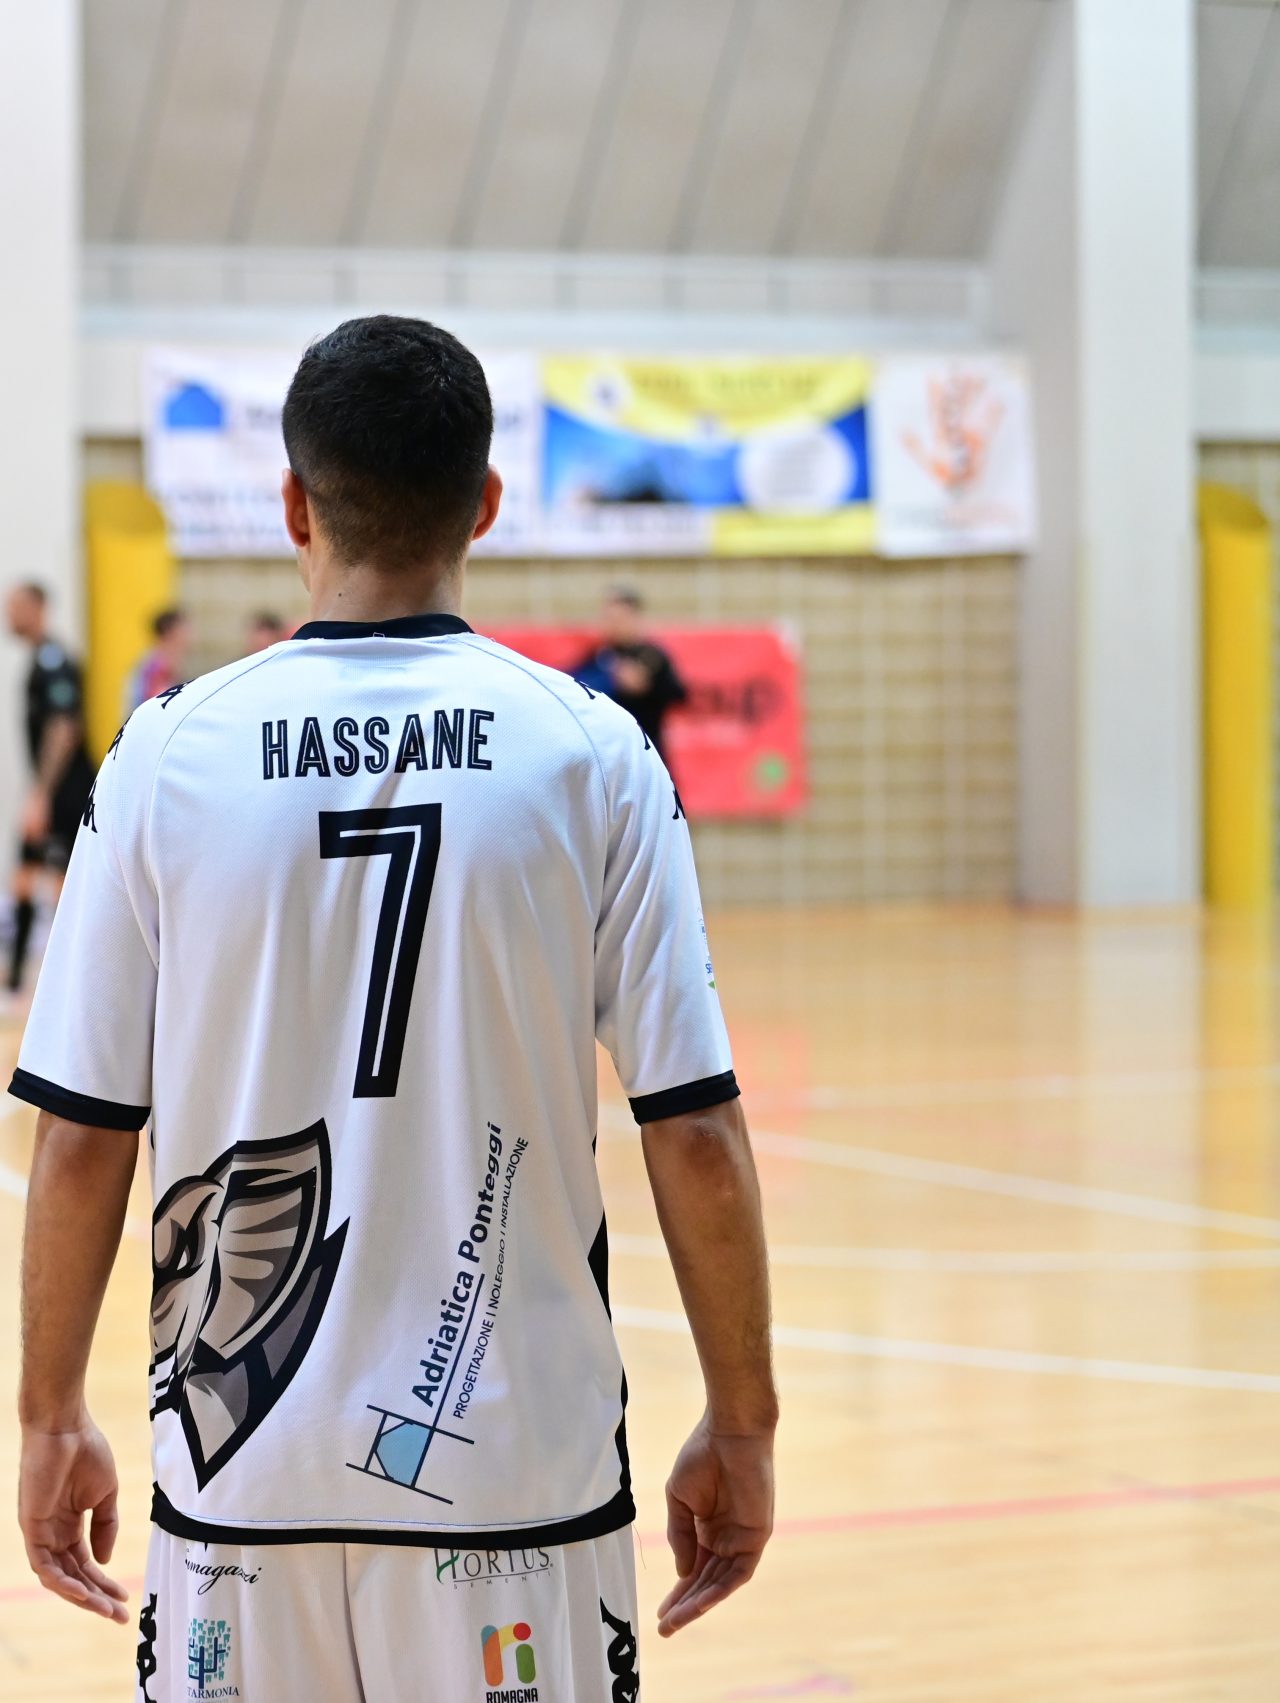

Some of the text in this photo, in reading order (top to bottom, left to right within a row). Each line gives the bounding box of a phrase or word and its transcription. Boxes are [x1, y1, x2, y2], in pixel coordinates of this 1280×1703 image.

[261, 708, 495, 781] HASSANE
[318, 802, 443, 1099] 7
[411, 1121, 503, 1408] Adriatica Ponteggi
[452, 1318, 495, 1420] PROGETTAZIONE
[487, 1239, 507, 1310] NOLEGGIO
[500, 1136, 530, 1228] INSTALLAZIONE
[486, 1688, 539, 1703] ROMAGNA
